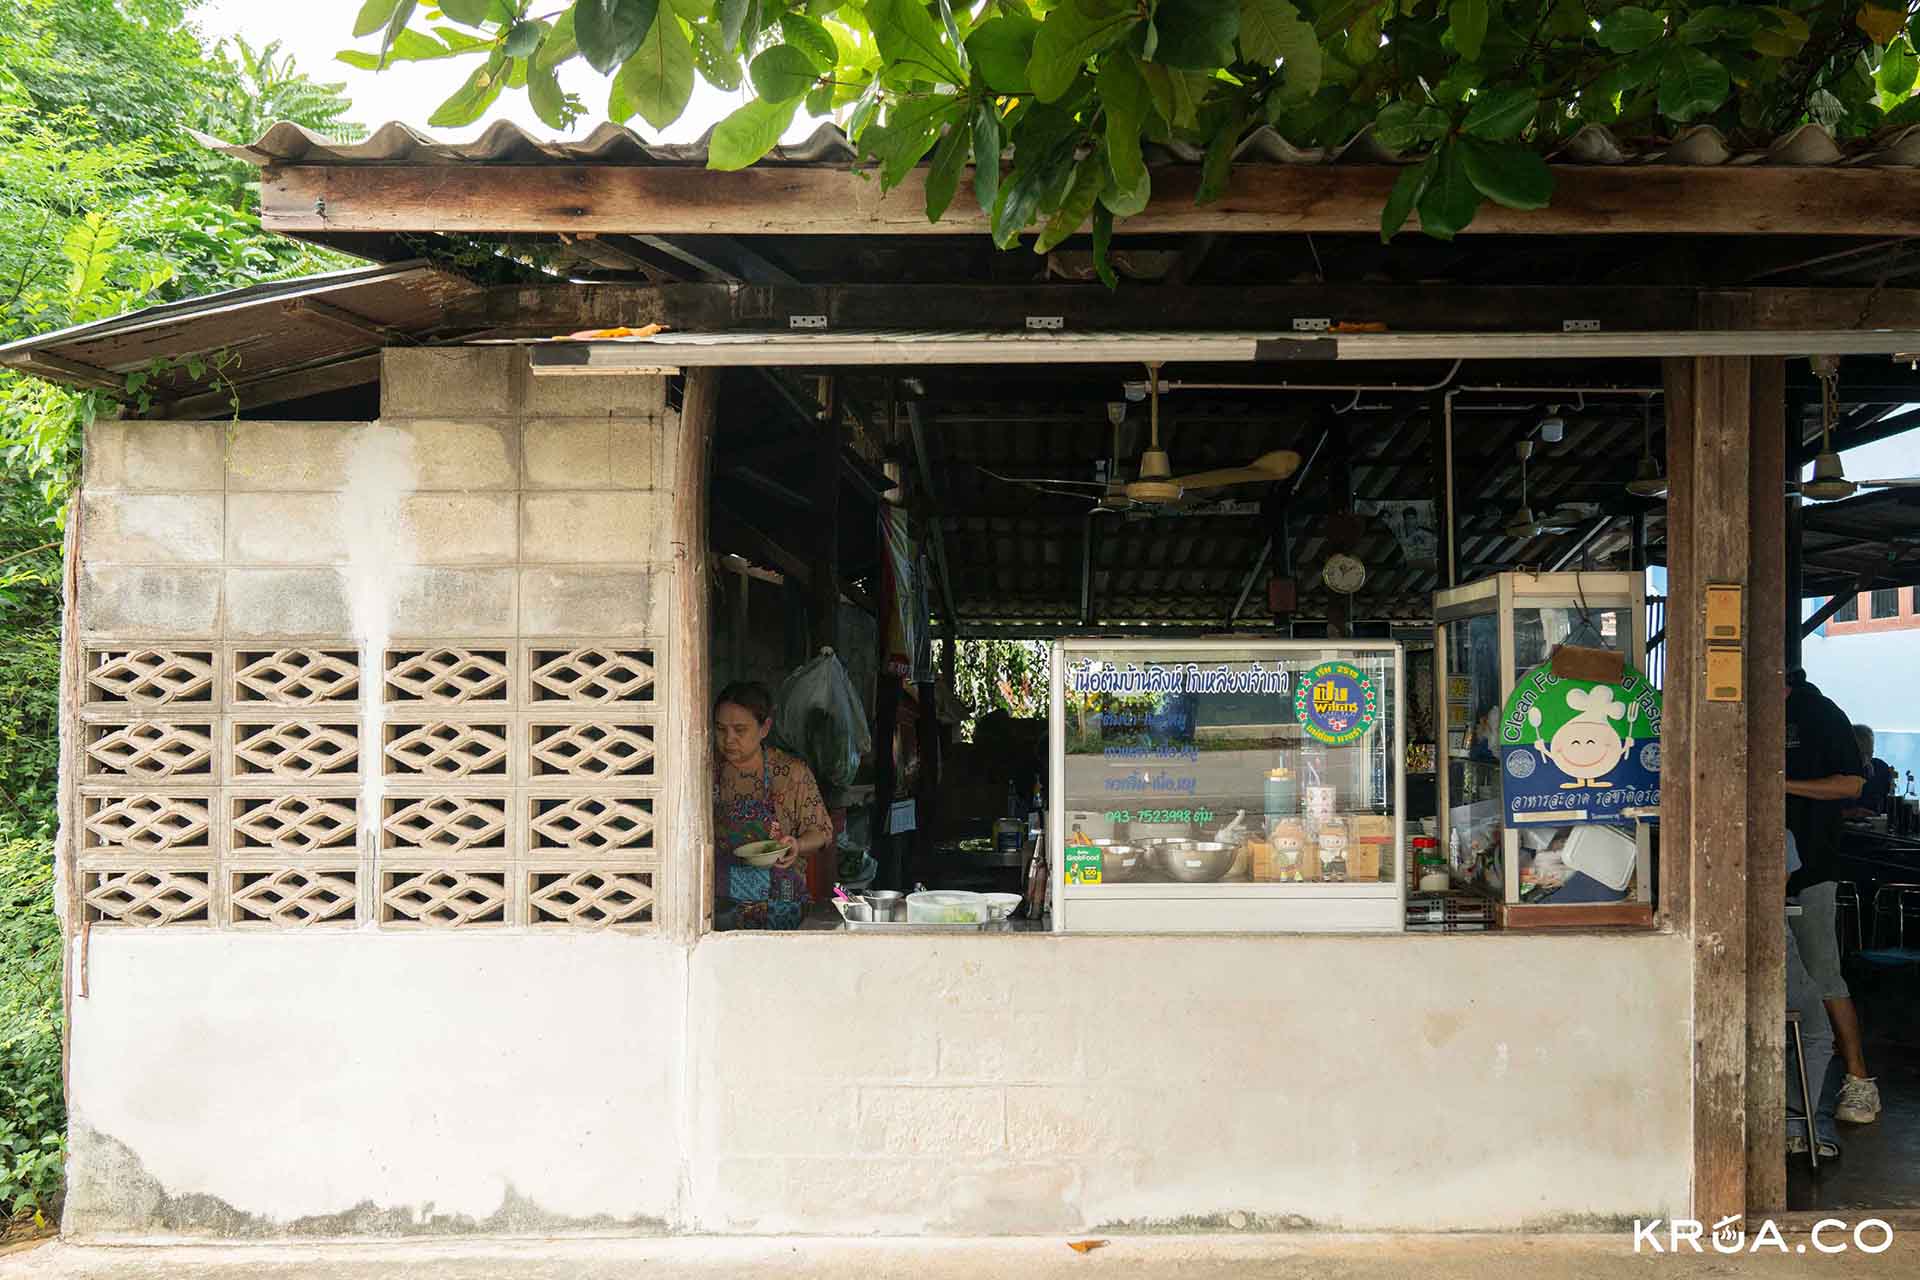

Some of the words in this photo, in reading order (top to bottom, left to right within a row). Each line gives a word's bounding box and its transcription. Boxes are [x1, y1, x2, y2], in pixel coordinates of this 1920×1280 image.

[1075, 657, 1183, 693] เนื้อต้มบ้านสิงห์
[1185, 661, 1289, 694] โกเหลียงเจ้าเก่า
[1503, 688, 1538, 742] Clean
[1511, 792, 1591, 812] อาหารสะอาด
[1596, 783, 1661, 808] รสชาติอร่อ
